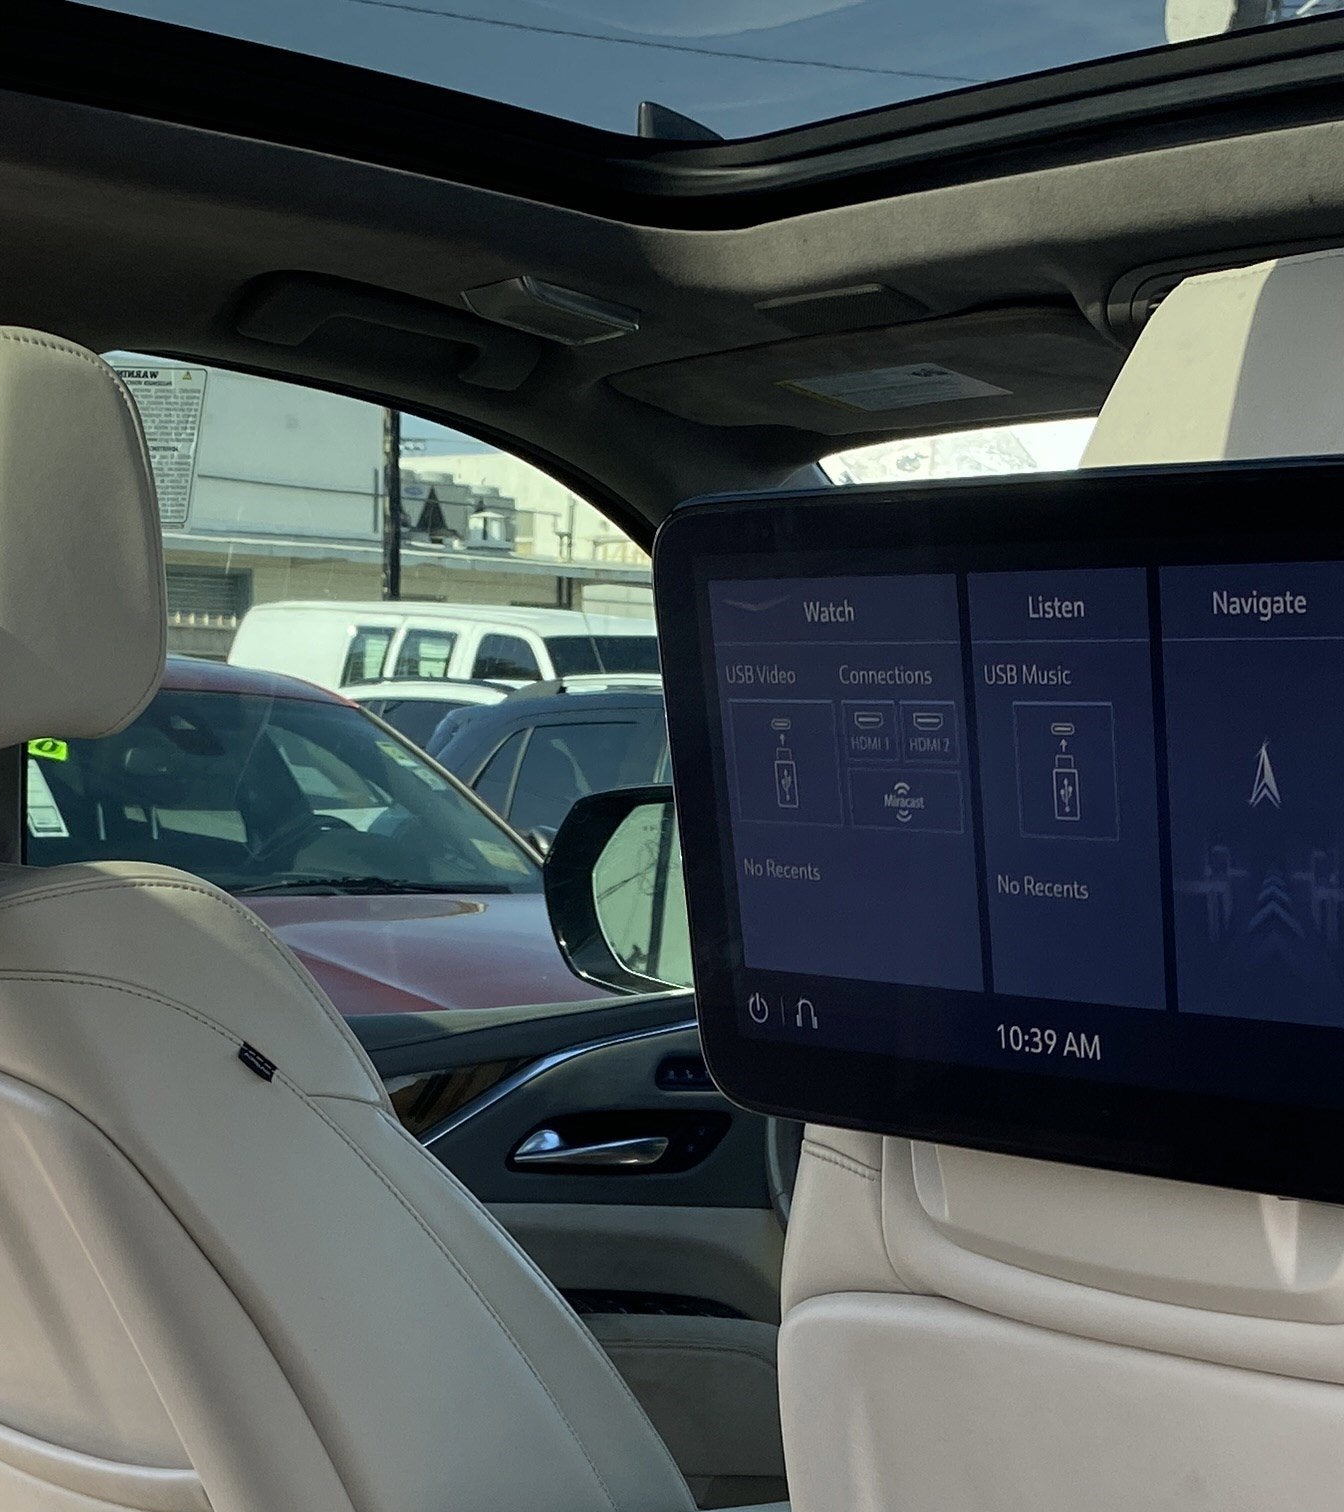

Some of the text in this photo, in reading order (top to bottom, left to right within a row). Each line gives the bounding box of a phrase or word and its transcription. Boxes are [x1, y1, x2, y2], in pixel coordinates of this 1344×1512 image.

[803, 599, 855, 622] Watch
[1028, 595, 1085, 618] Listen
[1212, 590, 1306, 622] Navigate
[725, 664, 797, 685] USB Video
[838, 664, 933, 685] Connections
[983, 664, 1072, 686] USB Music
[851, 736, 882, 751] HDMI
[909, 737, 941, 752] HDMI
[883, 793, 925, 810] Miracast
[743, 857, 822, 881] No Recents
[997, 873, 1090, 900] No Recents
[996, 1023, 1102, 1061] 10:39 AM
